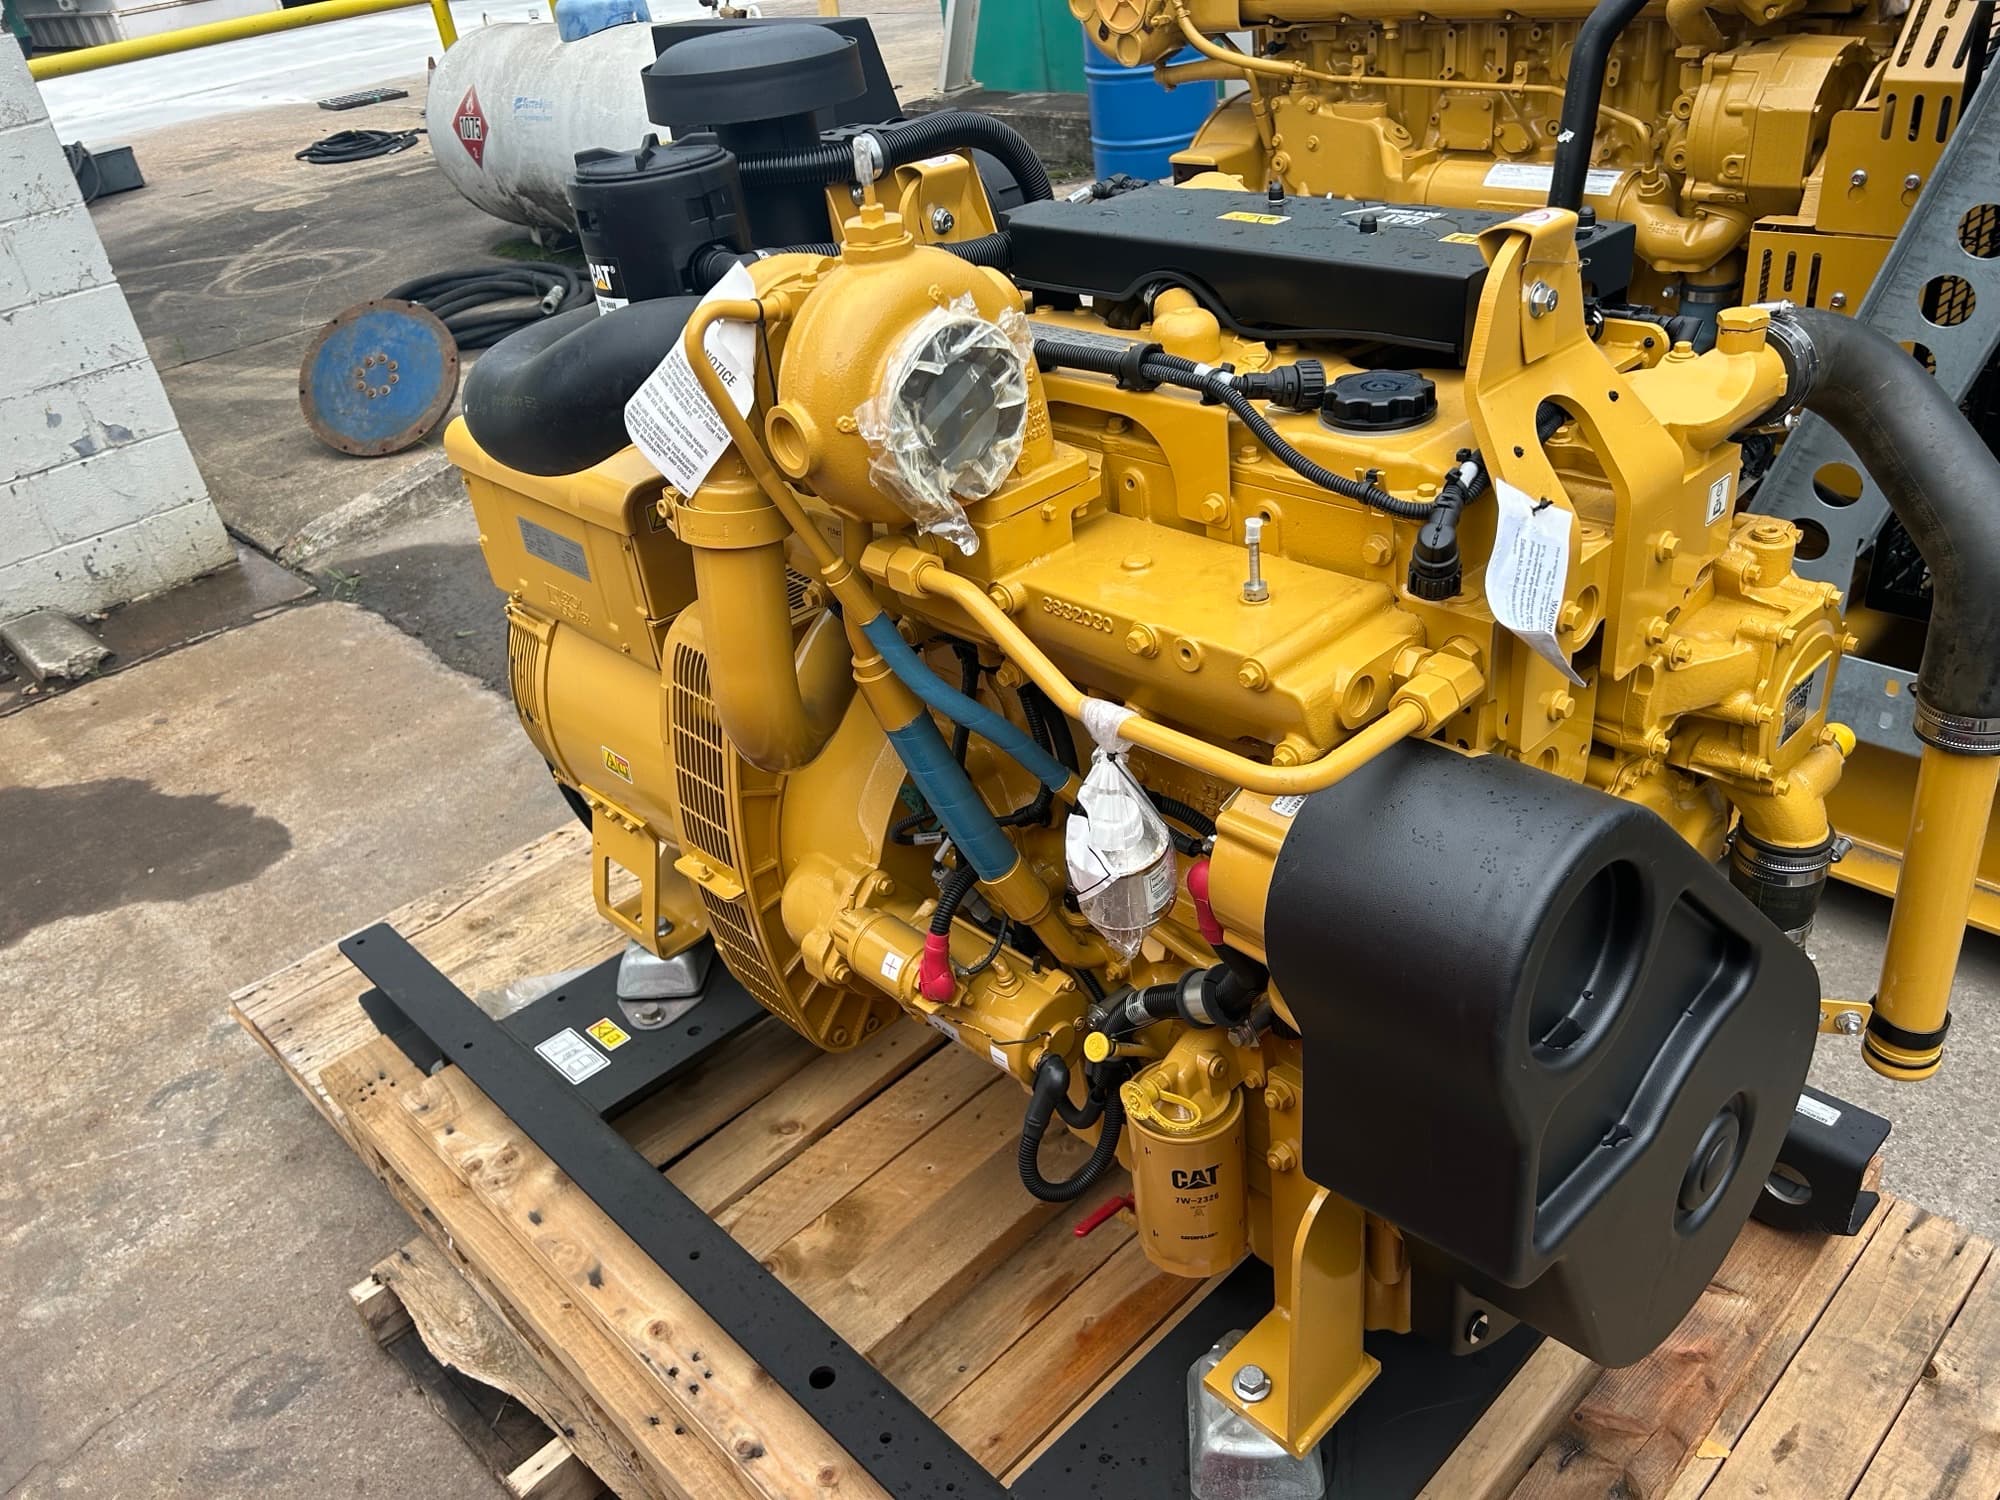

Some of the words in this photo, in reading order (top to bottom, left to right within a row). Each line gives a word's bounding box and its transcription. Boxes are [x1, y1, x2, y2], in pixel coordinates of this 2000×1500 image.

[461, 117, 482, 140] 1075
[472, 147, 479, 159] 2
[669, 450, 694, 476] PERMANENT
[1172, 1165, 1220, 1190] CAT
[1176, 1193, 1220, 1204] 7W-2326
